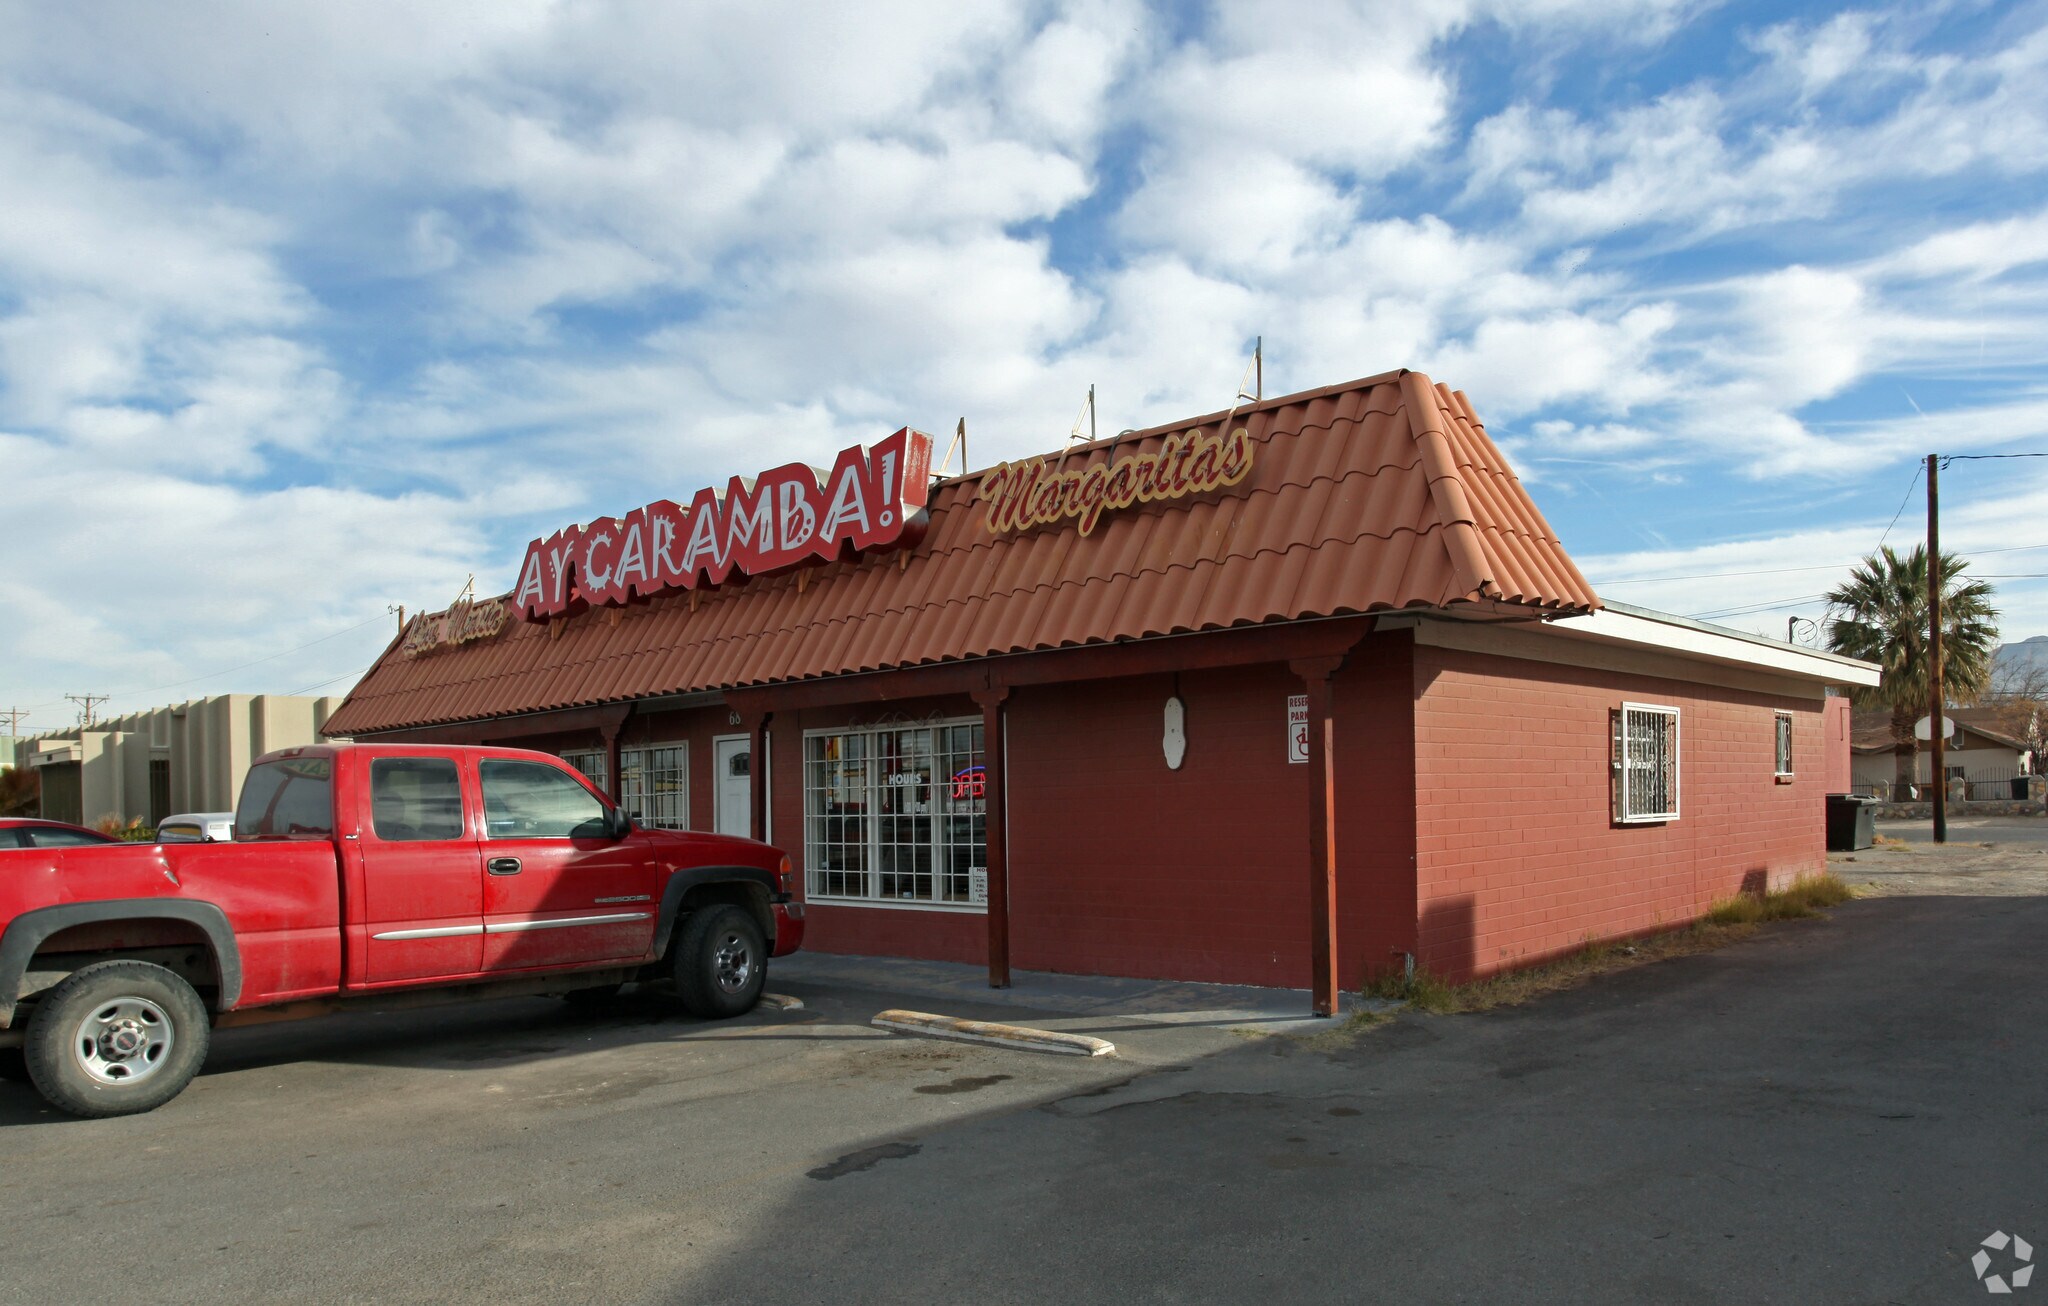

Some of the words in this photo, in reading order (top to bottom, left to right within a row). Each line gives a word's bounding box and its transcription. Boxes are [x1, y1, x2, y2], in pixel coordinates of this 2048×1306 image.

[516, 540, 574, 609] AY
[583, 449, 897, 594] CARAMBA!
[982, 429, 1251, 535] Margaritas
[888, 773, 922, 785] HOURS
